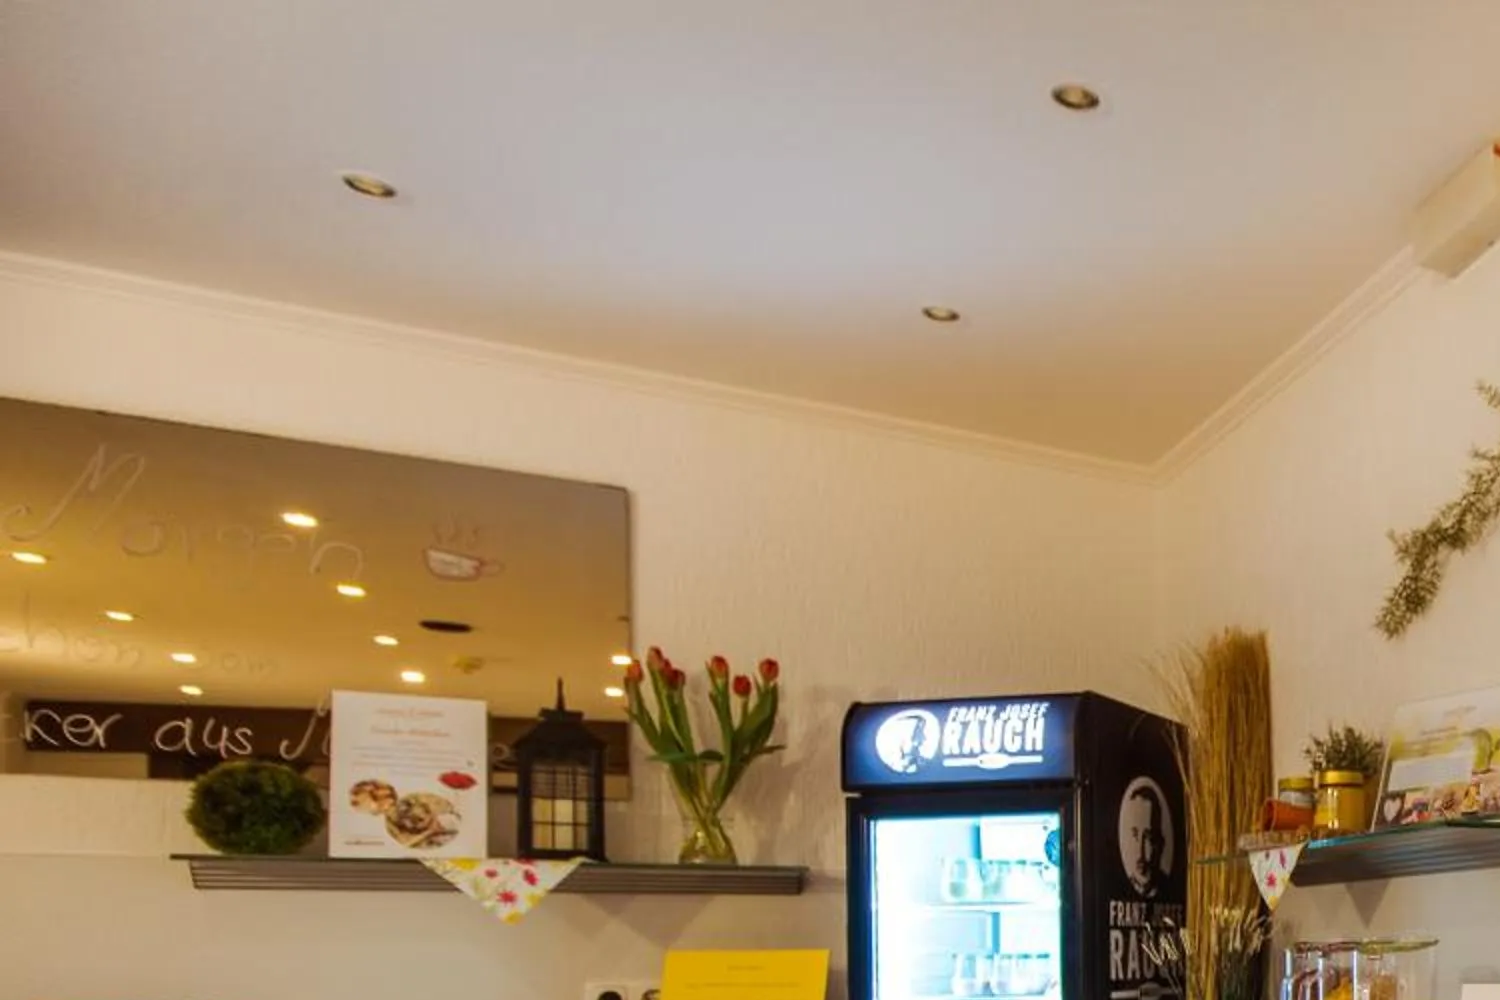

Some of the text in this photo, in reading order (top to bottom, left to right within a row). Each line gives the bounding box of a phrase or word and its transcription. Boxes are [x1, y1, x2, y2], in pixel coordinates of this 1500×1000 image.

[948, 701, 1051, 722] FRANZ JOSEF
[153, 715, 254, 759] aus
[942, 717, 1045, 755] RAUCH
[1108, 899, 1147, 938] FRANZ
